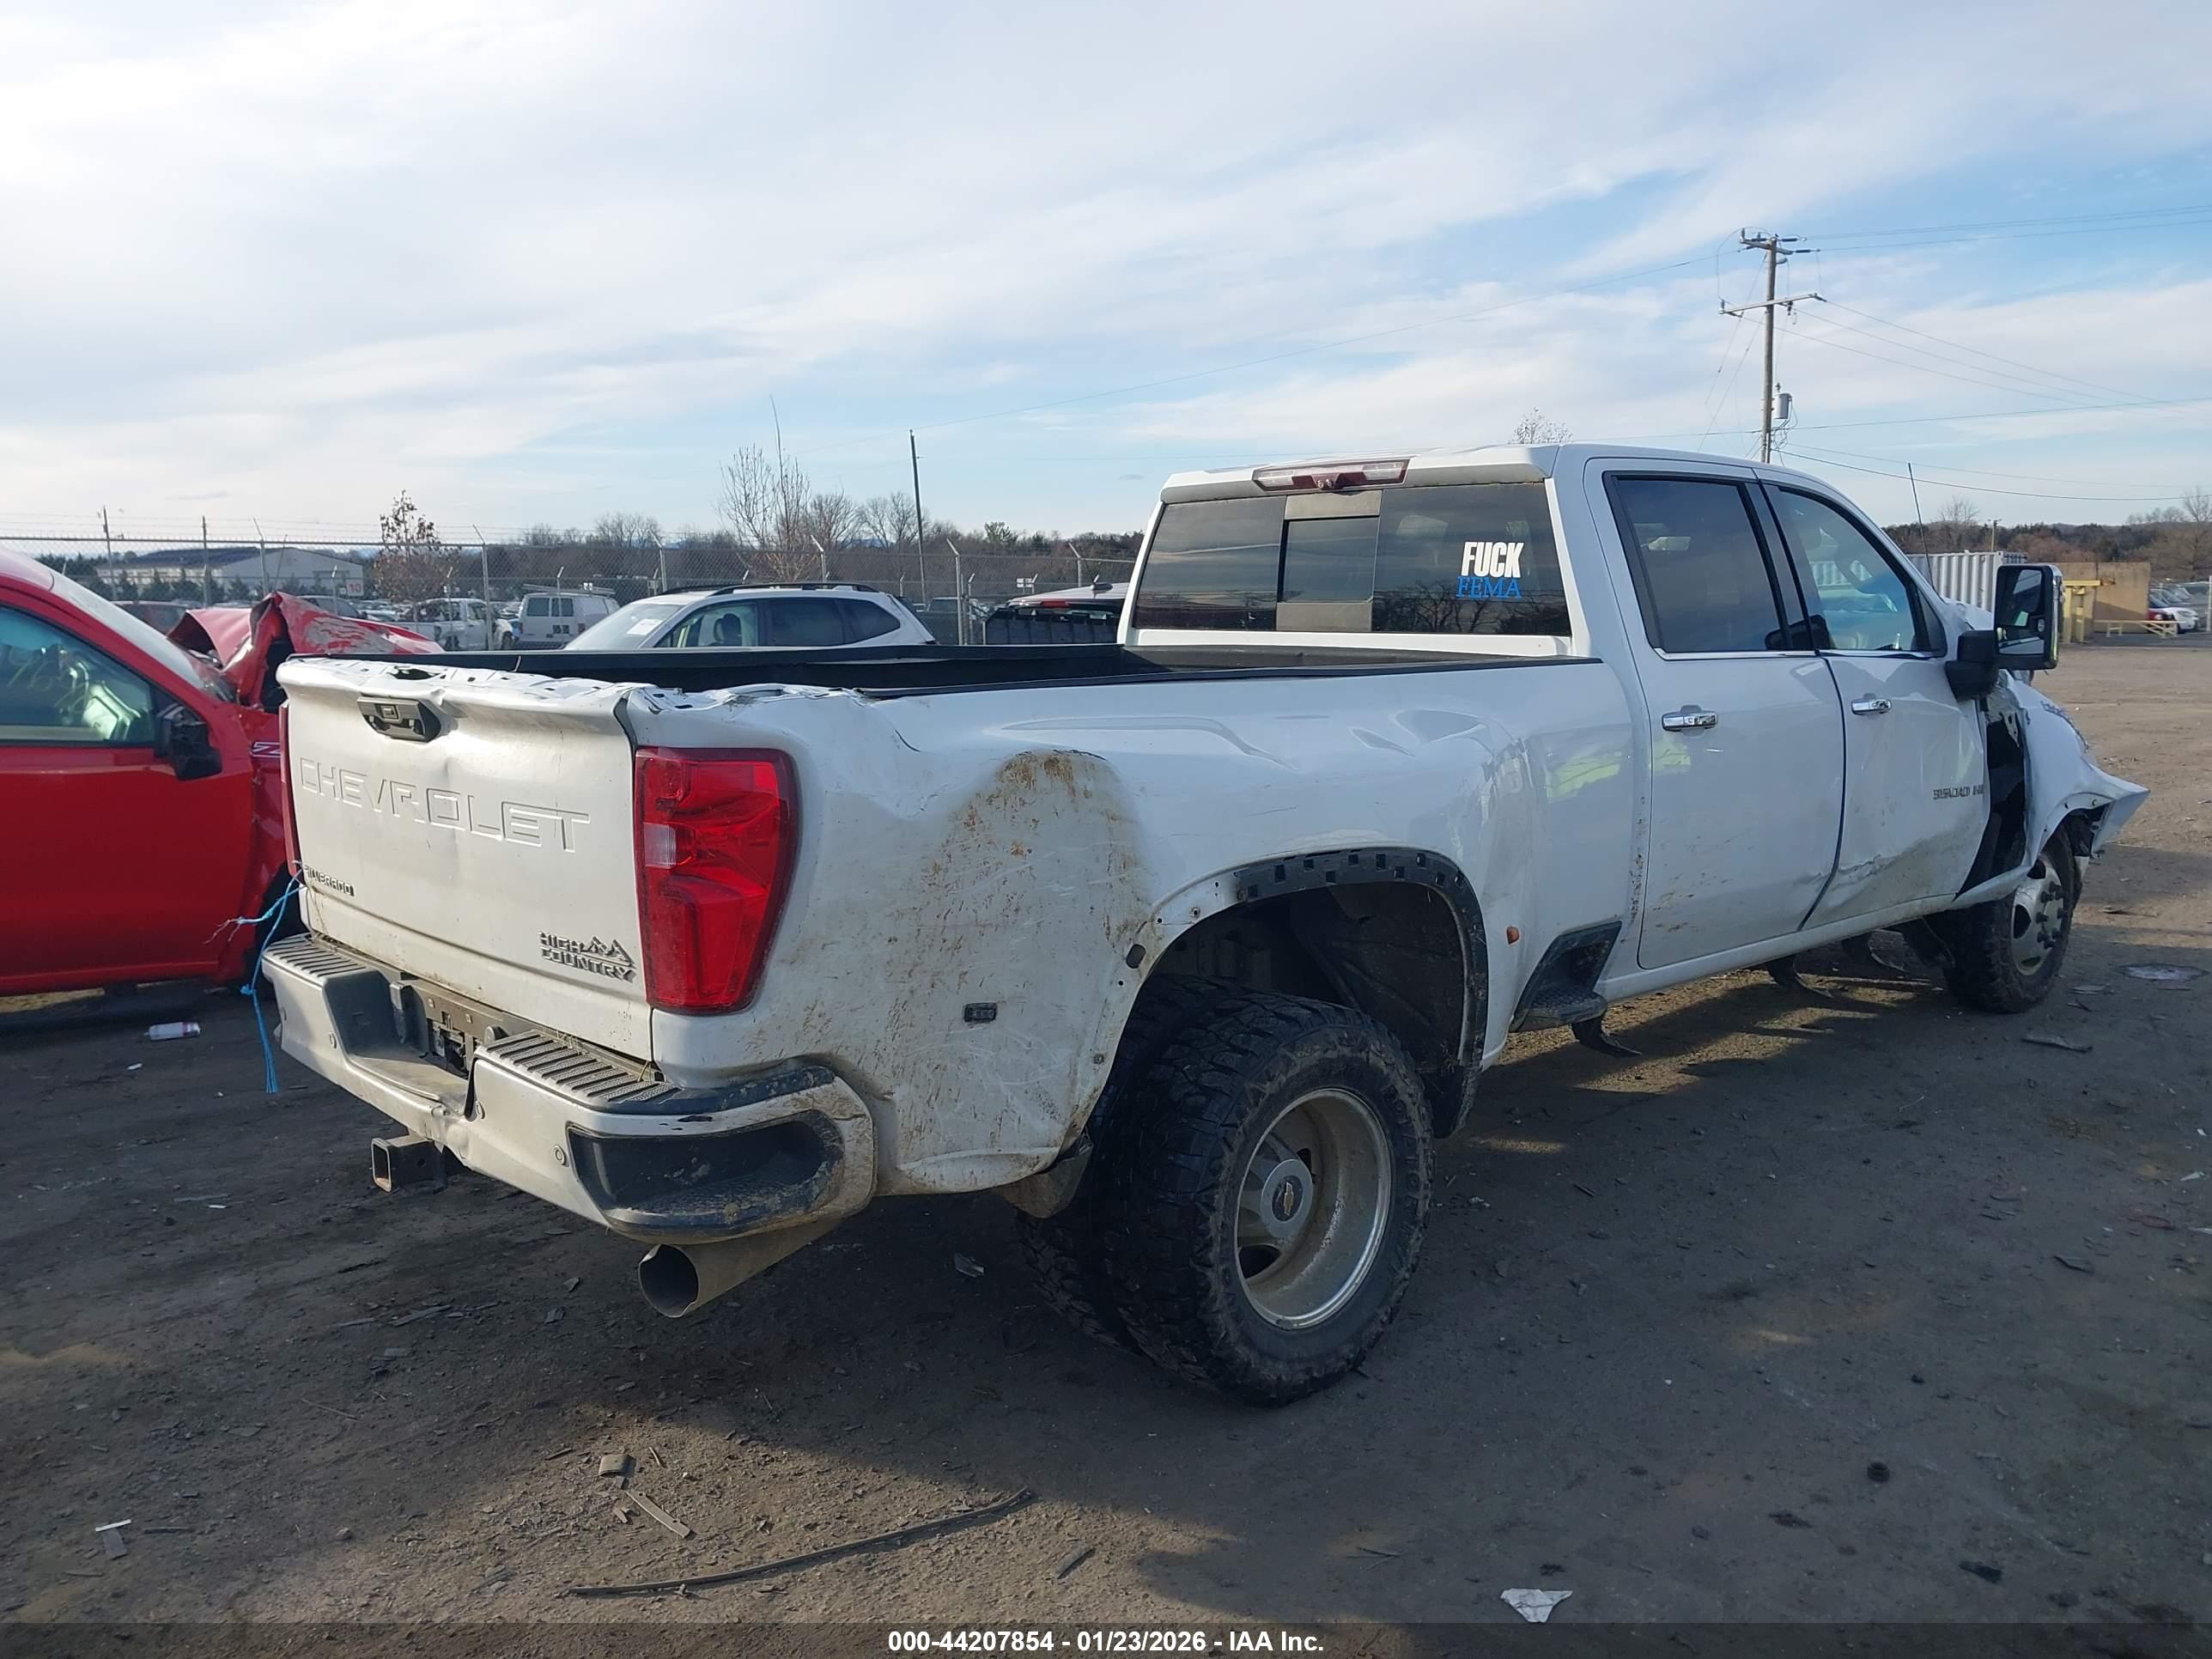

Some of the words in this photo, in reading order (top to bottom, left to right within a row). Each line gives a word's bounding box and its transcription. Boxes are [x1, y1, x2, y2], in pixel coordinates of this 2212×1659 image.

[1460, 541, 1525, 578] FUCK
[1456, 576, 1523, 599] FEMA
[300, 757, 591, 853] CHEVROLET
[303, 864, 355, 897] SILVERADO
[538, 930, 586, 955] HIGH
[540, 945, 637, 983] COUNTRY
